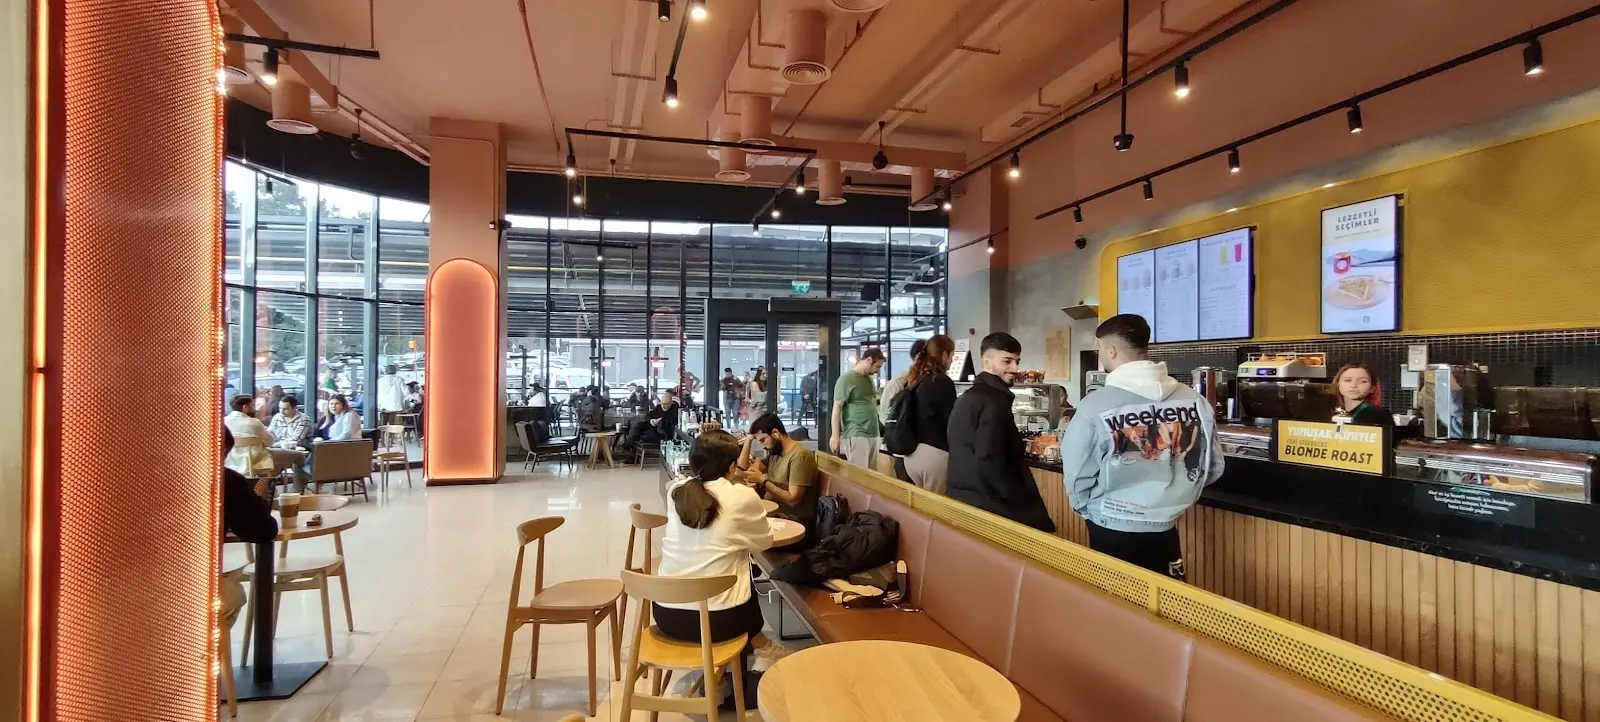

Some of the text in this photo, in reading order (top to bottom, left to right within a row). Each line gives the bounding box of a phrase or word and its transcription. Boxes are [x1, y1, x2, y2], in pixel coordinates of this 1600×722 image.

[1335, 217, 1379, 231] SEÇİMLER
[1337, 208, 1377, 223] LEZZETLİ
[1105, 402, 1200, 430] weekend
[1285, 445, 1373, 464] BLONDE ROAST
